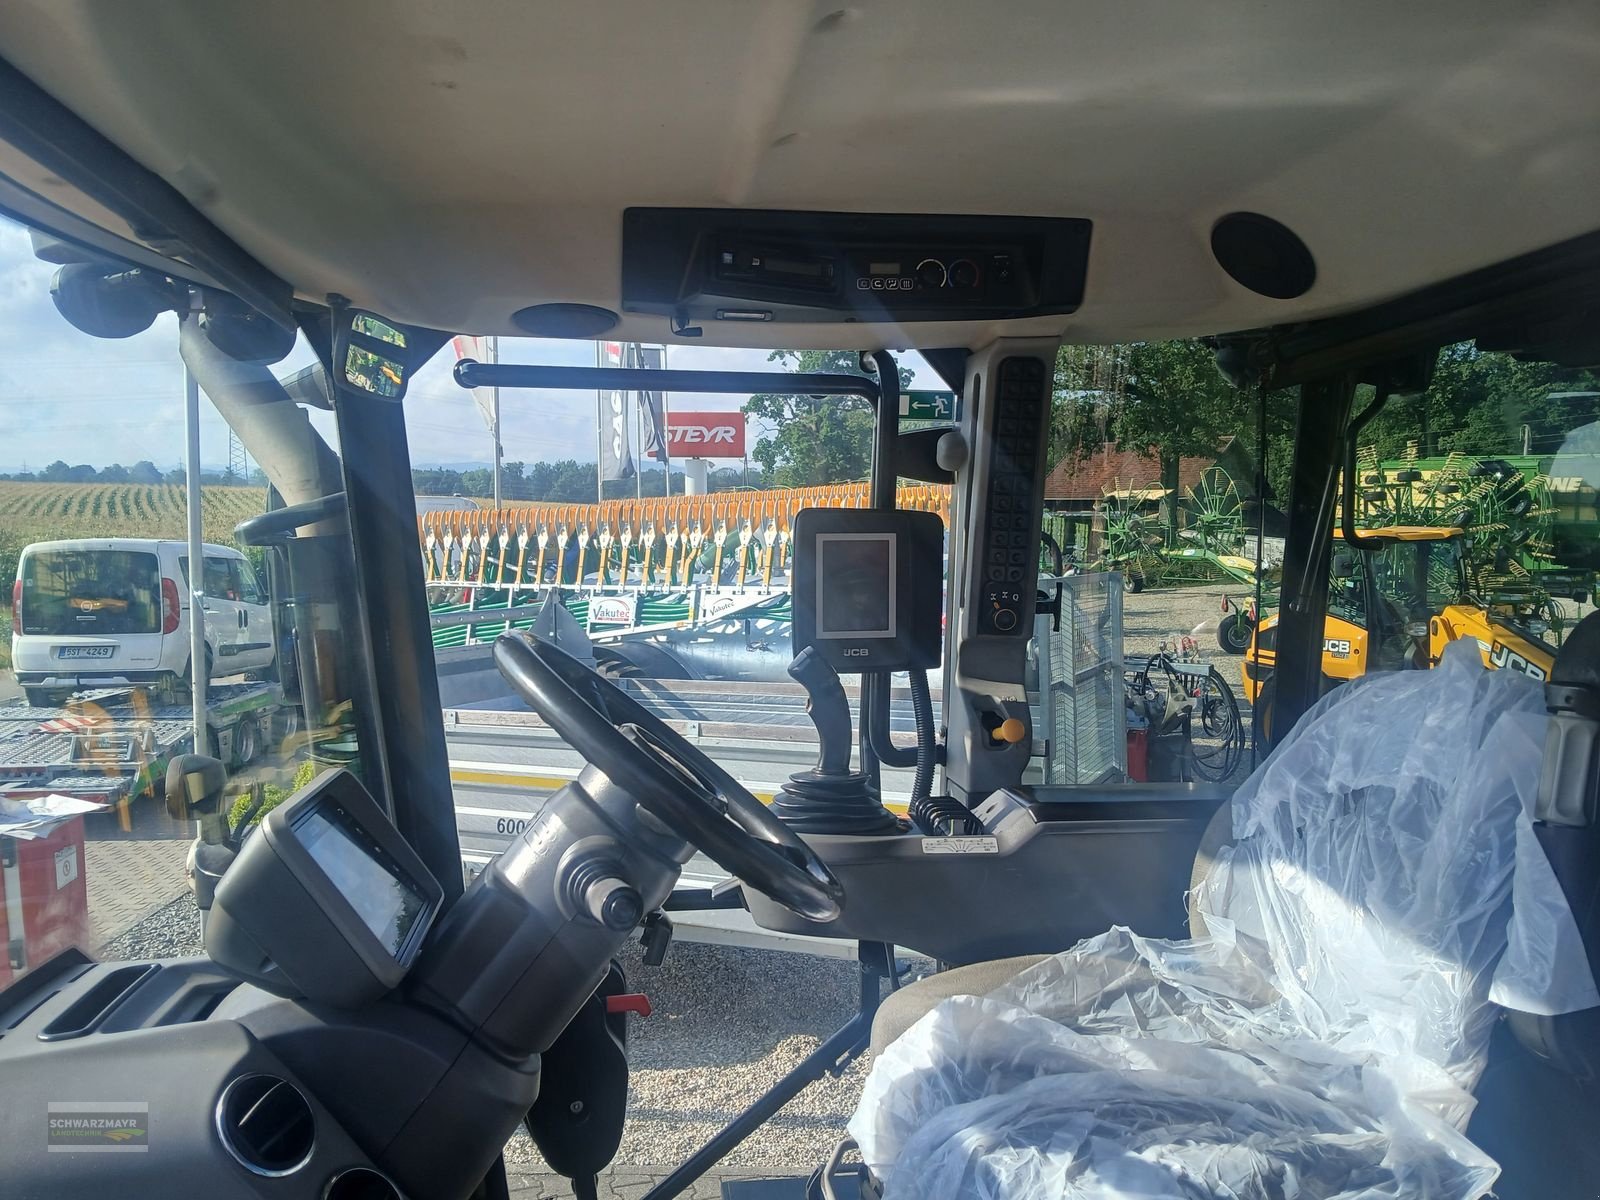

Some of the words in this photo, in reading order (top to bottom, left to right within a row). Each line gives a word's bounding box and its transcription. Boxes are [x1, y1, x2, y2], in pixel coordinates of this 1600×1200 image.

[611, 391, 623, 460] CAS
[593, 605, 630, 620] Vakutec
[86, 648, 109, 656] 4249
[843, 648, 869, 657] JCB
[1323, 640, 1350, 652] JCB
[496, 817, 531, 835] 600
